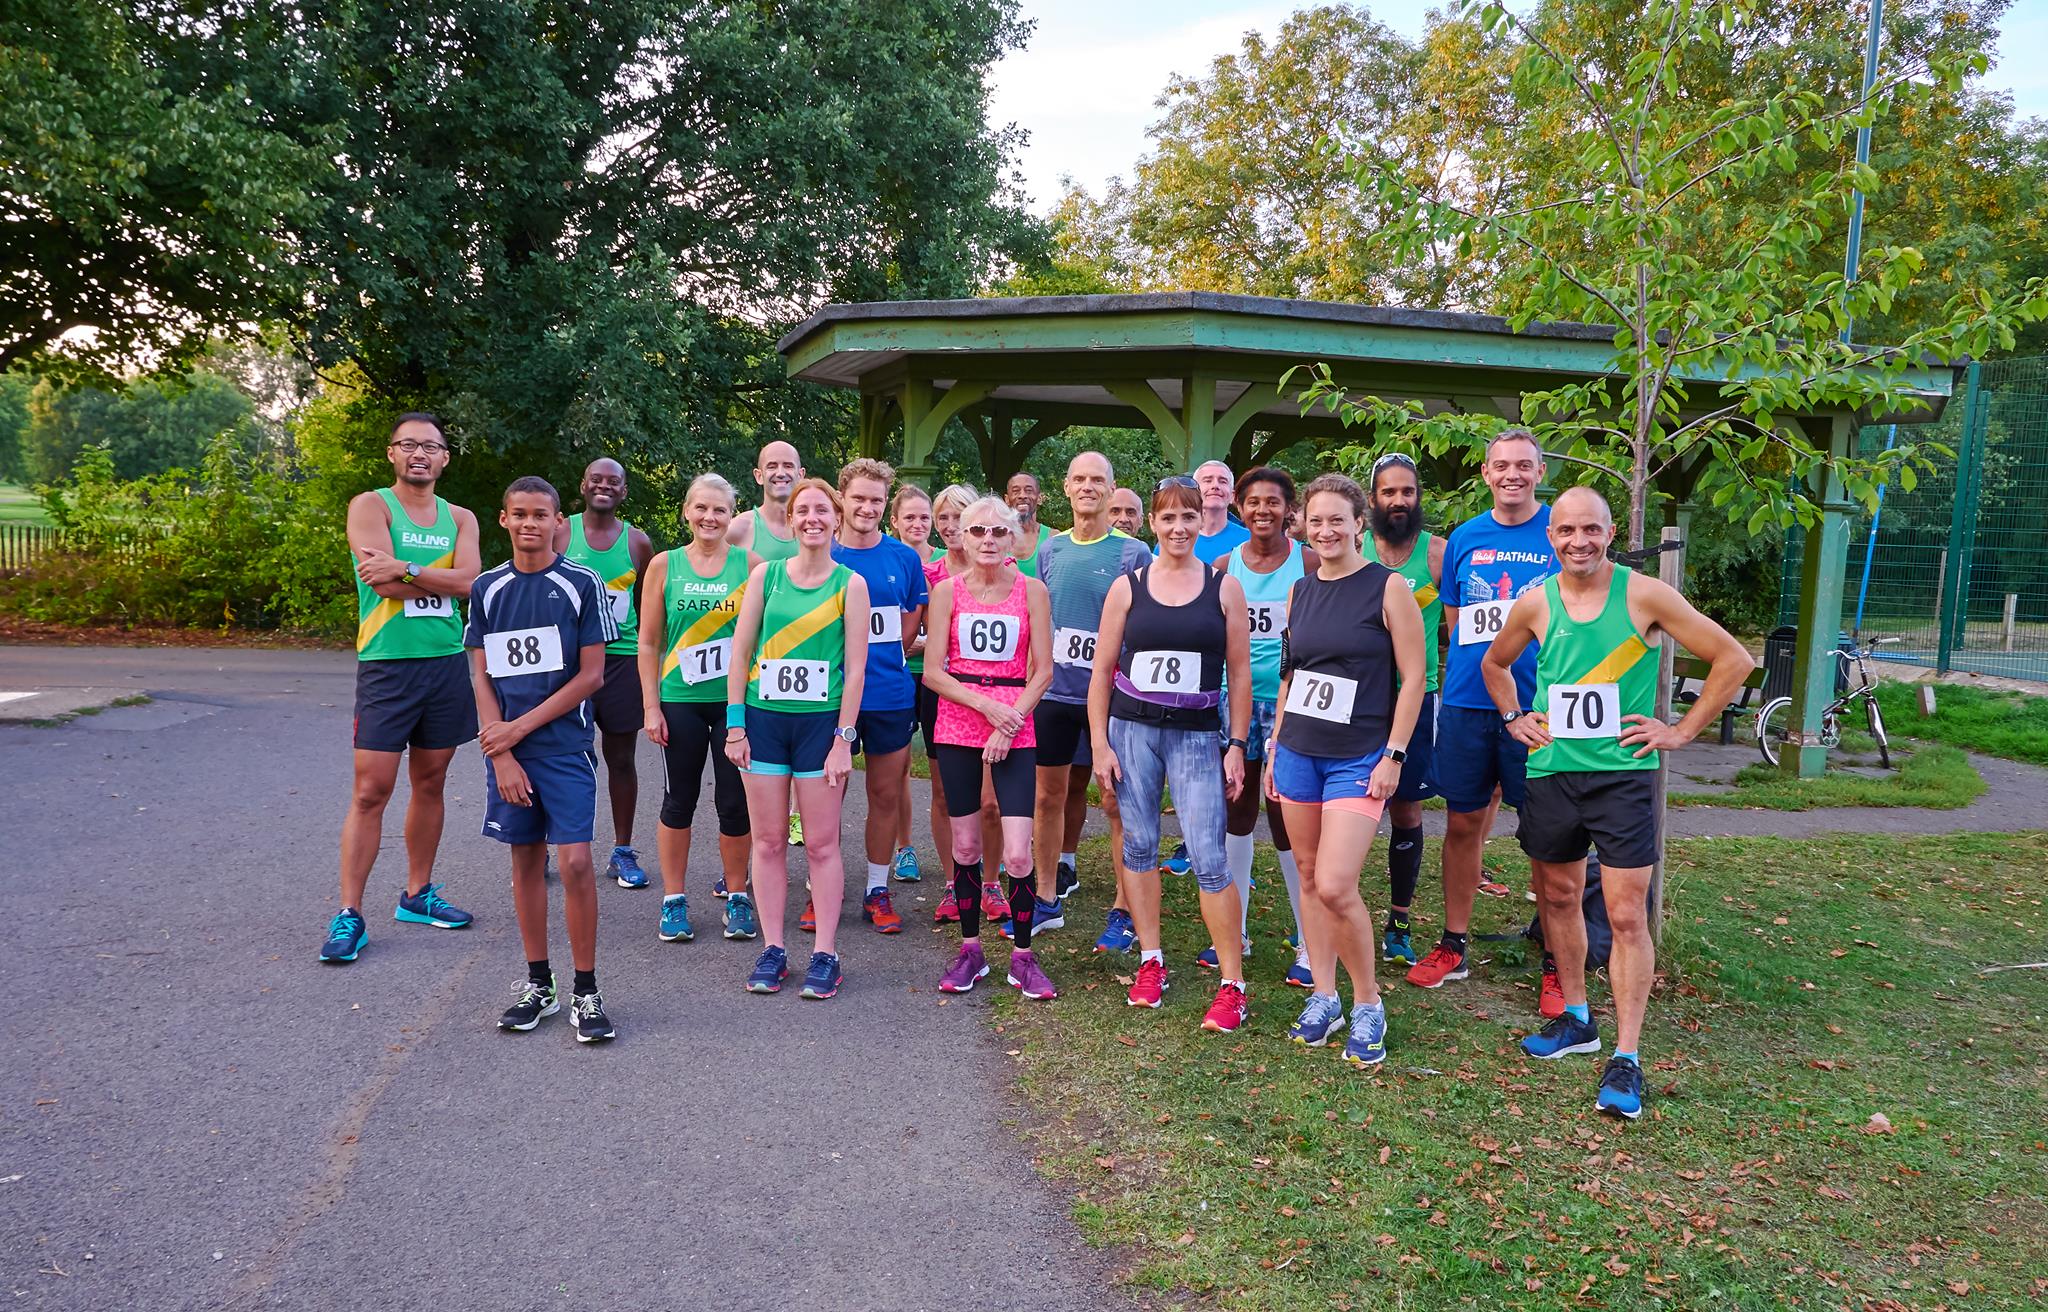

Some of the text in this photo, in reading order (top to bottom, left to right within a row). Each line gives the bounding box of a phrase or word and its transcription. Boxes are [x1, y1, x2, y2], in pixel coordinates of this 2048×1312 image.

[402, 532, 449, 546] EALING
[1496, 551, 1548, 564] BATHALF
[684, 583, 728, 592] EALING
[677, 599, 735, 612] SARAH
[1248, 607, 1272, 632] 65
[1474, 606, 1502, 634] 98
[970, 619, 1007, 653] 69
[1067, 635, 1096, 661] 86
[507, 635, 541, 667] 88
[695, 645, 721, 674] 77
[778, 665, 808, 693] 68
[1150, 657, 1181, 684] 78
[1303, 678, 1334, 710] 79
[1561, 691, 1603, 729] 70
